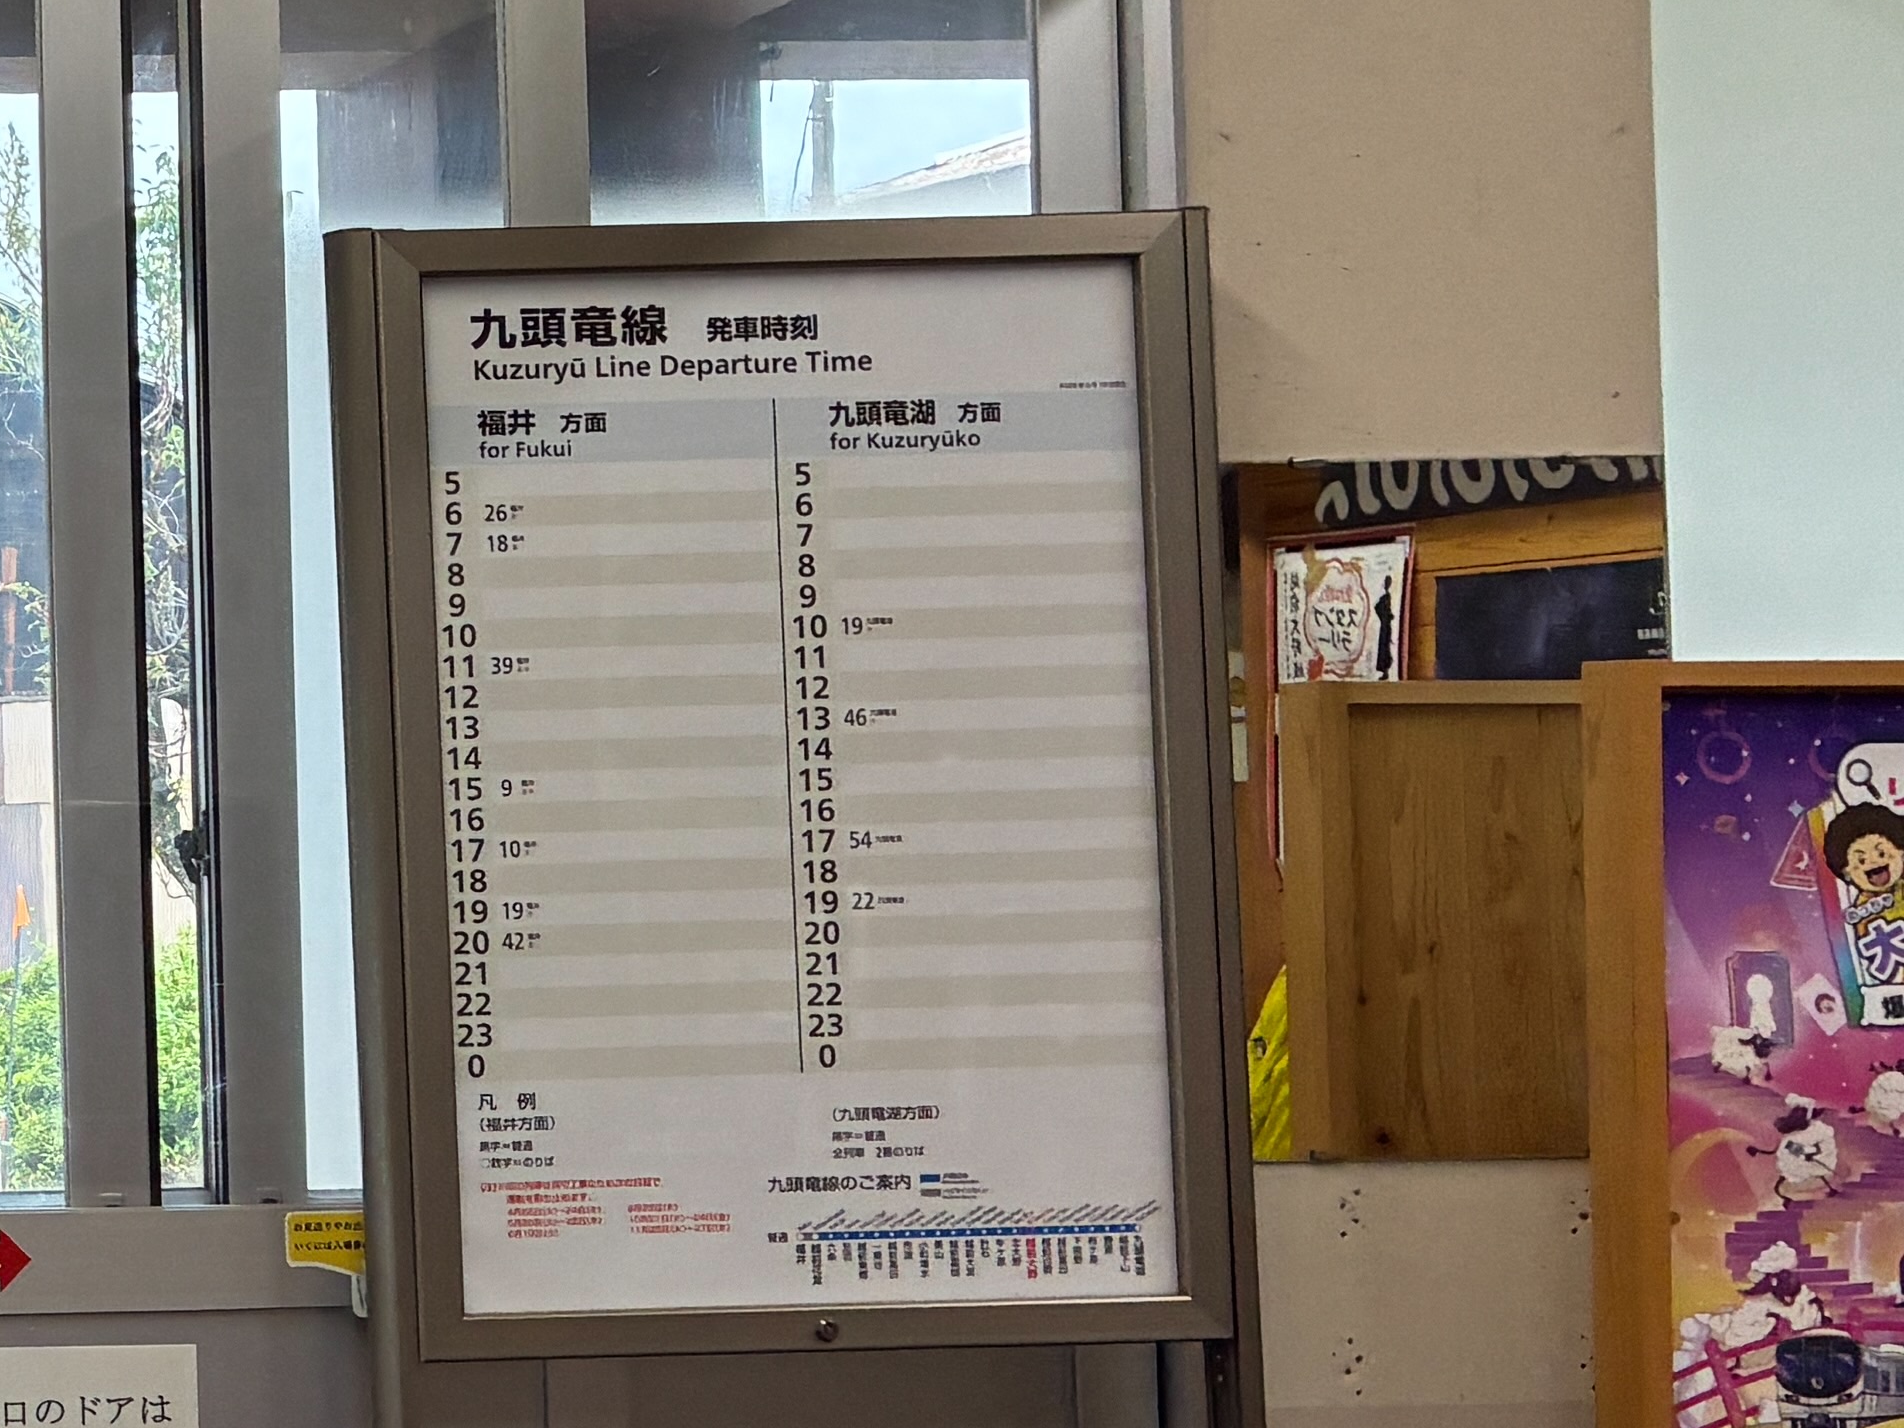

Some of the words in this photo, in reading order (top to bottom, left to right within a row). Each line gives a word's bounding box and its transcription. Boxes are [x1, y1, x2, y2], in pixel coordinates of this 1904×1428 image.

[470, 304, 667, 349] 九頭竜線
[707, 314, 817, 342] 発車時刻
[473, 357, 587, 385] Kuzuryū
[596, 357, 651, 378] Line
[661, 353, 798, 380] Departure
[806, 350, 873, 373] Time
[477, 409, 536, 436] 福井
[560, 412, 606, 433] 方面
[829, 399, 935, 427] 九頭竜湖
[958, 402, 1001, 423] 方面
[479, 441, 509, 458] for
[515, 440, 572, 457] Fukui
[830, 432, 860, 449] for
[867, 429, 981, 452] Kuzuryūko
[445, 471, 460, 495] 5
[796, 463, 810, 486] 5
[446, 502, 462, 525] 6
[485, 504, 507, 522] 26
[796, 493, 813, 516] 6
[446, 533, 462, 556] 7
[488, 535, 508, 552] 18
[797, 524, 813, 547] 7
[448, 563, 464, 586] 8
[799, 554, 815, 577] 8
[449, 594, 465, 617] 9
[800, 585, 816, 608] 9
[442, 624, 476, 648] 10
[793, 615, 827, 638] 10
[842, 617, 863, 635] 19
[443, 654, 473, 678] 11
[491, 657, 513, 674] 39
[794, 646, 824, 669] 11
[444, 685, 479, 709] 12
[796, 676, 829, 700] 12
[446, 716, 479, 740] 13
[797, 706, 830, 730] 13
[844, 708, 867, 726] 46
[447, 747, 482, 770] 14
[798, 738, 832, 761] 14
[449, 777, 482, 801] 15
[501, 779, 512, 797] 9
[799, 768, 832, 791] 15
[450, 807, 484, 831] 16
[800, 798, 835, 822] 16
[451, 839, 484, 862] 17
[500, 840, 520, 858] 10
[802, 829, 835, 853] 17
[850, 831, 872, 849] 54
[453, 869, 487, 892] 18
[803, 860, 837, 883] 18
[453, 900, 487, 924] 19
[503, 902, 523, 919] 19
[804, 890, 838, 914] 19
[852, 892, 875, 910] 22
[454, 930, 489, 955] 20
[502, 932, 524, 950] 42
[805, 921, 839, 945] 20
[455, 962, 486, 985] 21
[806, 952, 837, 975] 21
[457, 993, 491, 1016] 22
[807, 983, 842, 1006] 22
[458, 1023, 492, 1047] 23
[809, 1013, 843, 1037] 23
[468, 1054, 485, 1078] 0
[819, 1044, 835, 1068] 0
[478, 1093, 536, 1110] 凡例
[768, 1174, 911, 1193] 九頭竜線のご案内
